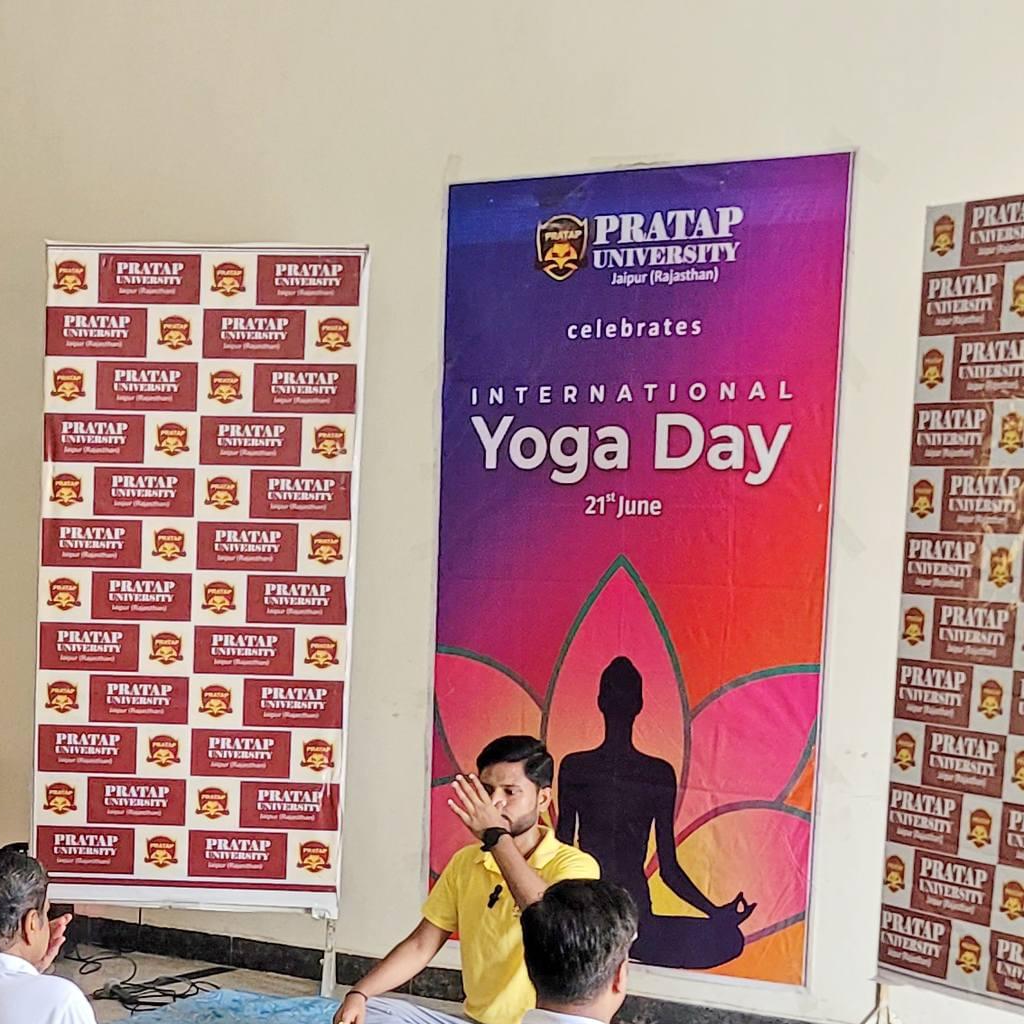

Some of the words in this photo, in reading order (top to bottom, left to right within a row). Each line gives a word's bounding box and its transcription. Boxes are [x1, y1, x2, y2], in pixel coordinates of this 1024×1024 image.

[592, 206, 744, 245] PRATAP
[545, 230, 582, 241] PRATAP
[592, 242, 741, 269] UNIVERSITY
[117, 263, 183, 276] PRATAP
[276, 264, 343, 278] PRATAP
[116, 276, 182, 287] UNIVERSITY
[275, 277, 342, 288] UNIVERSITY
[611, 271, 647, 287] Jaipur
[650, 266, 719, 286] (Rajasthan)
[928, 273, 997, 299] PRATAP
[64, 316, 130, 330] PRATAP
[222, 318, 288, 332] PRATAP
[567, 317, 702, 340] celebrates
[63, 329, 128, 340] UNIVERSITY
[221, 331, 286, 342] UNIVERSITY
[115, 370, 180, 384] PRATAP
[272, 372, 338, 386] PRATAP
[114, 383, 178, 394] UNIVERSITY
[271, 385, 336, 396] UNIVERSITY
[471, 380, 793, 405] INTERNATIONAL
[917, 408, 986, 430] PRATAP
[62, 422, 127, 436] PRATAP
[218, 425, 285, 438] PRATAP
[61, 435, 126, 446] UNIVERSITY
[217, 438, 284, 449] UNIVERSITY
[470, 415, 630, 484] Yoga
[654, 412, 792, 486] Day
[112, 476, 178, 490] PRATAP
[269, 479, 335, 492] PRATAP
[949, 475, 1020, 496] PRATAP
[111, 489, 176, 500] UNIVERSITY
[268, 492, 334, 503] UNIVERSITY
[584, 492, 615, 515] 21st
[617, 497, 662, 519] June
[60, 527, 125, 540] PRATAP
[215, 530, 281, 544] PRATAP
[59, 540, 124, 551] UNIVERSITY
[214, 543, 280, 554] UNIVERSITY
[908, 539, 976, 561] PRATAP
[110, 580, 175, 594] PRATAP
[265, 584, 331, 598] PRATAP
[109, 593, 174, 604] UNIVERSITY
[264, 597, 330, 608] UNIVERSITY
[940, 605, 1009, 630] PRATAP
[58, 631, 122, 644] PRATAP
[212, 635, 277, 648] PRATAP
[57, 644, 120, 655] UNIVERSITY
[211, 648, 276, 659] UNIVERSITY
[900, 665, 967, 691] PRATAP
[107, 684, 172, 698] PRATAP
[262, 688, 327, 702] PRATAP
[106, 697, 170, 708] UNIVERSITY
[261, 701, 326, 712] UNIVERSITY
[56, 733, 120, 746] PRATAP
[209, 738, 274, 752] PRATAP
[930, 732, 1000, 759] PRATAP
[55, 746, 118, 757] UNIVERSITY
[208, 751, 272, 762] UNIVERSITY
[105, 786, 169, 800] PRATAP
[258, 789, 324, 802] PRATAP
[104, 799, 168, 810] UNIVERSITY
[257, 802, 322, 813] UNIVERSITY
[890, 789, 956, 818] PRATAP
[55, 834, 118, 848] PRATAP
[206, 839, 271, 852] PRATAP
[54, 847, 116, 858] UNIVERSITY
[205, 852, 270, 863] UNIVERSITY
[920, 857, 988, 889] PRATAP
[881, 910, 945, 942] PRATAP
